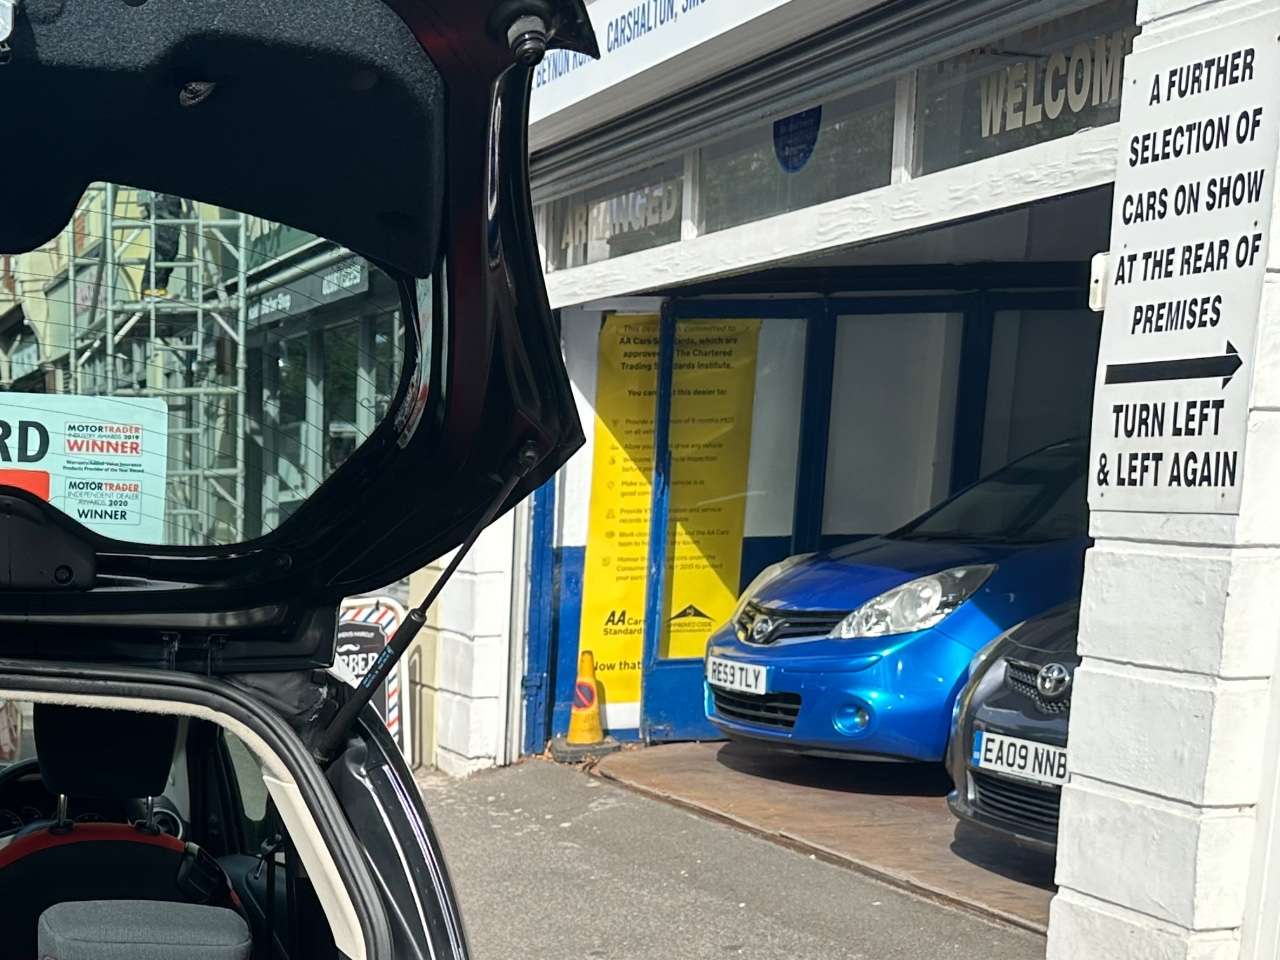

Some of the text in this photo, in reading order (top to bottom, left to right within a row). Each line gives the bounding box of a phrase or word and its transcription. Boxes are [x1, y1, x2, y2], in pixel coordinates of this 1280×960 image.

[607, 0, 677, 53] CARSHALTON,
[980, 33, 1122, 138] WELCOM
[1149, 48, 1255, 106] A FURTHER
[1129, 107, 1263, 167] SELECTION OF
[1122, 169, 1264, 226] CARS ON SHOW
[1114, 233, 1262, 285] AT THE REAR OF
[1131, 295, 1222, 334] PREMISES
[67, 424, 141, 434] MOTORTRADER
[1112, 399, 1225, 438] TURN LEFT
[66, 439, 140, 454] WINNER
[68, 481, 139, 492] MOTORTRADER
[1097, 451, 1238, 487] & LEFT AGAIN
[77, 508, 127, 520] WINNER
[108, 499, 128, 507] 2020
[603, 628, 642, 636] Standard
[605, 610, 641, 626] AA Car
[619, 660, 641, 671] that
[712, 661, 761, 690] RE59 TLY
[983, 737, 1067, 779] EA09 NNB
